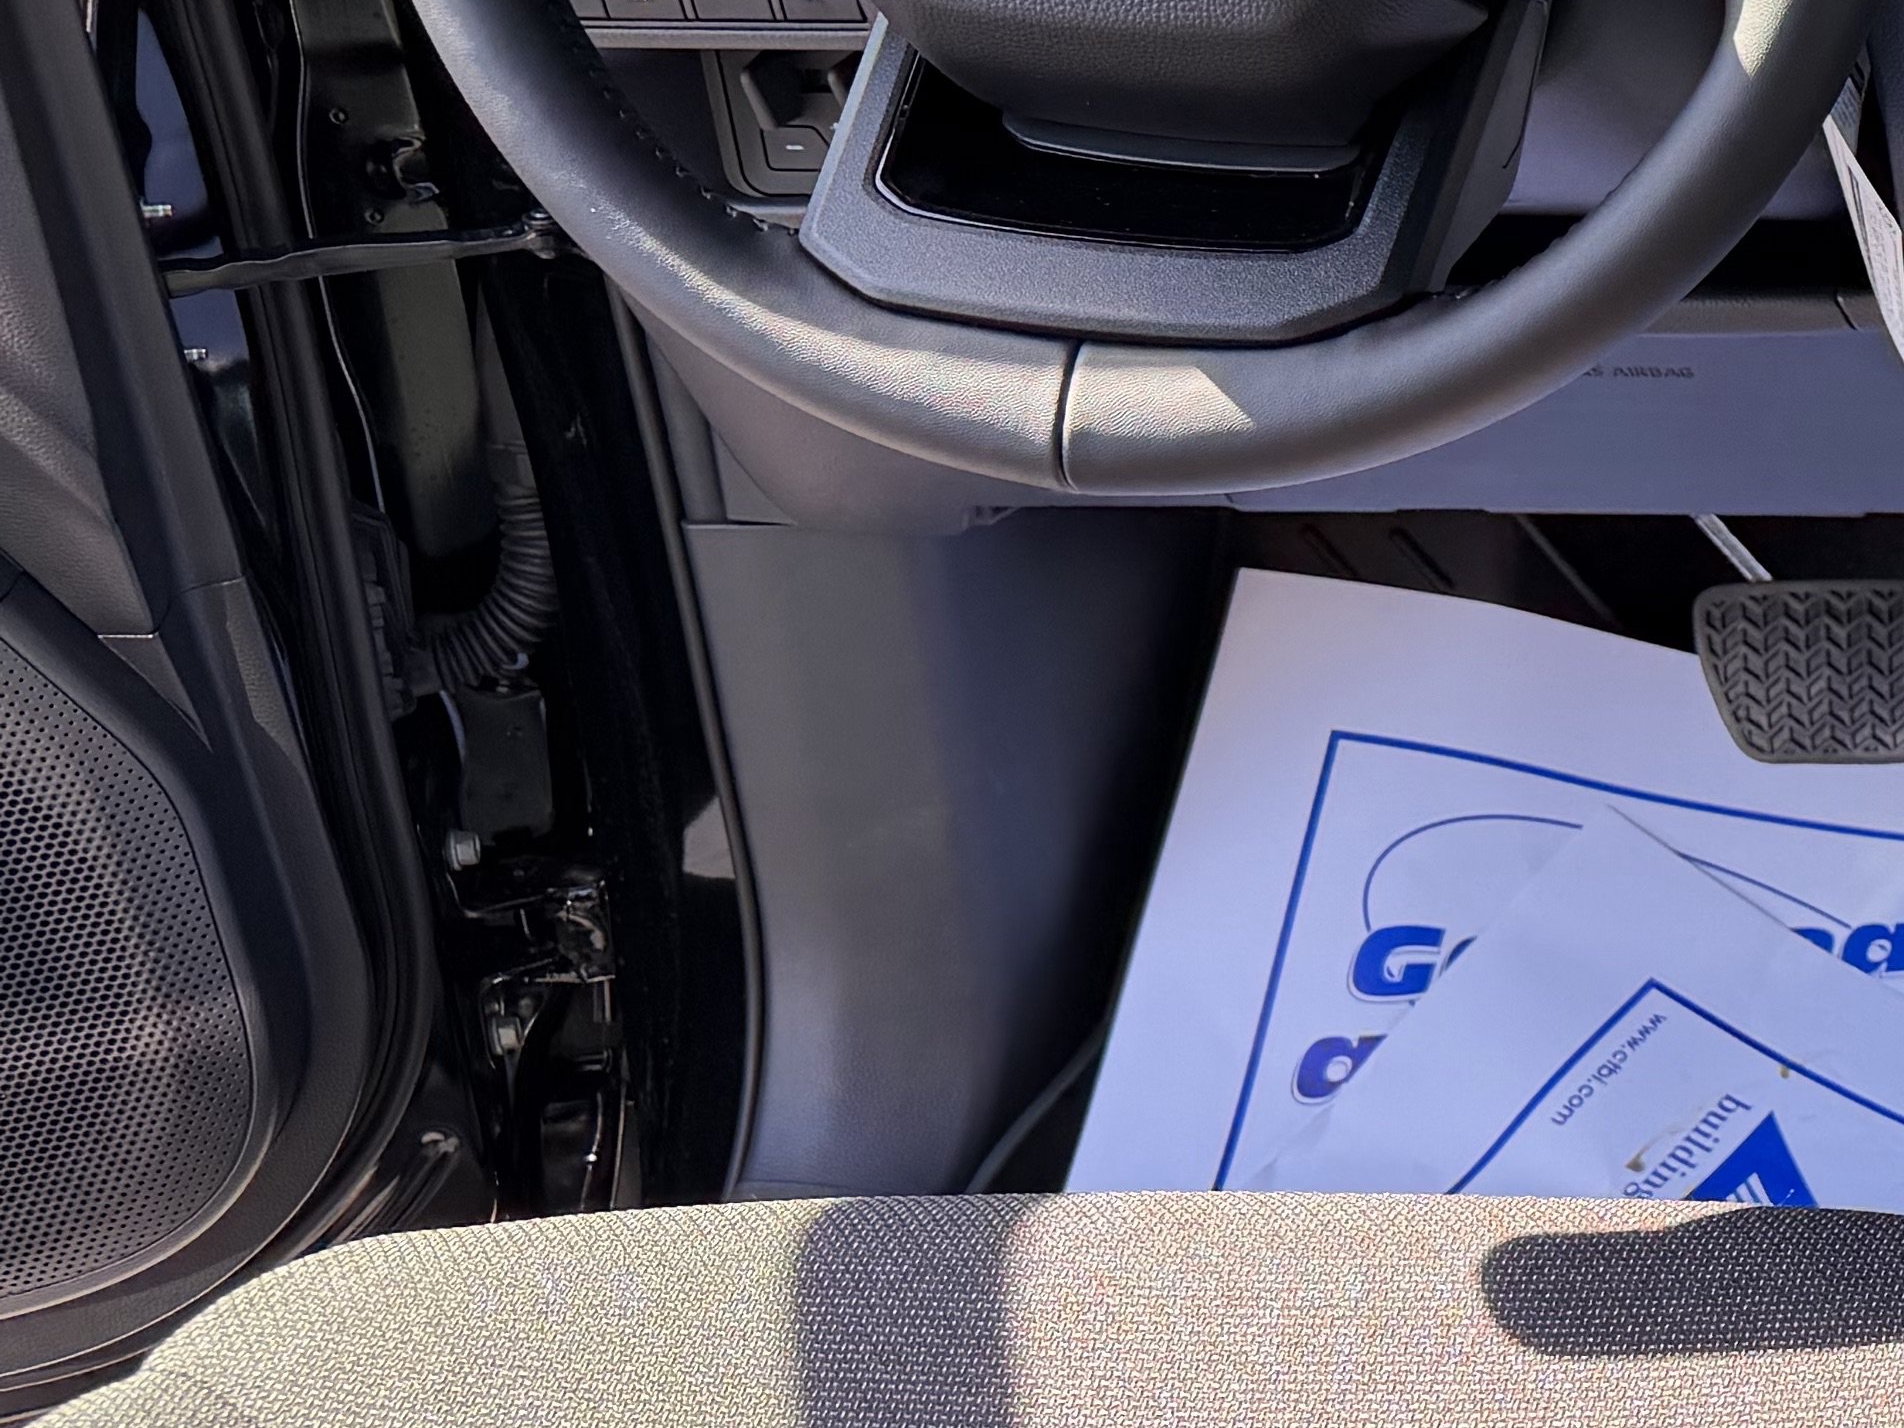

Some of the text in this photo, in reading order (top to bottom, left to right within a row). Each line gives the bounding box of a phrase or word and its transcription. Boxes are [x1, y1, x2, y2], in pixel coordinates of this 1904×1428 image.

[1613, 366, 1695, 378] AIRBAG
[1551, 1012, 1667, 1126] www.ctbi.com
[1622, 1093, 1752, 1199] building
